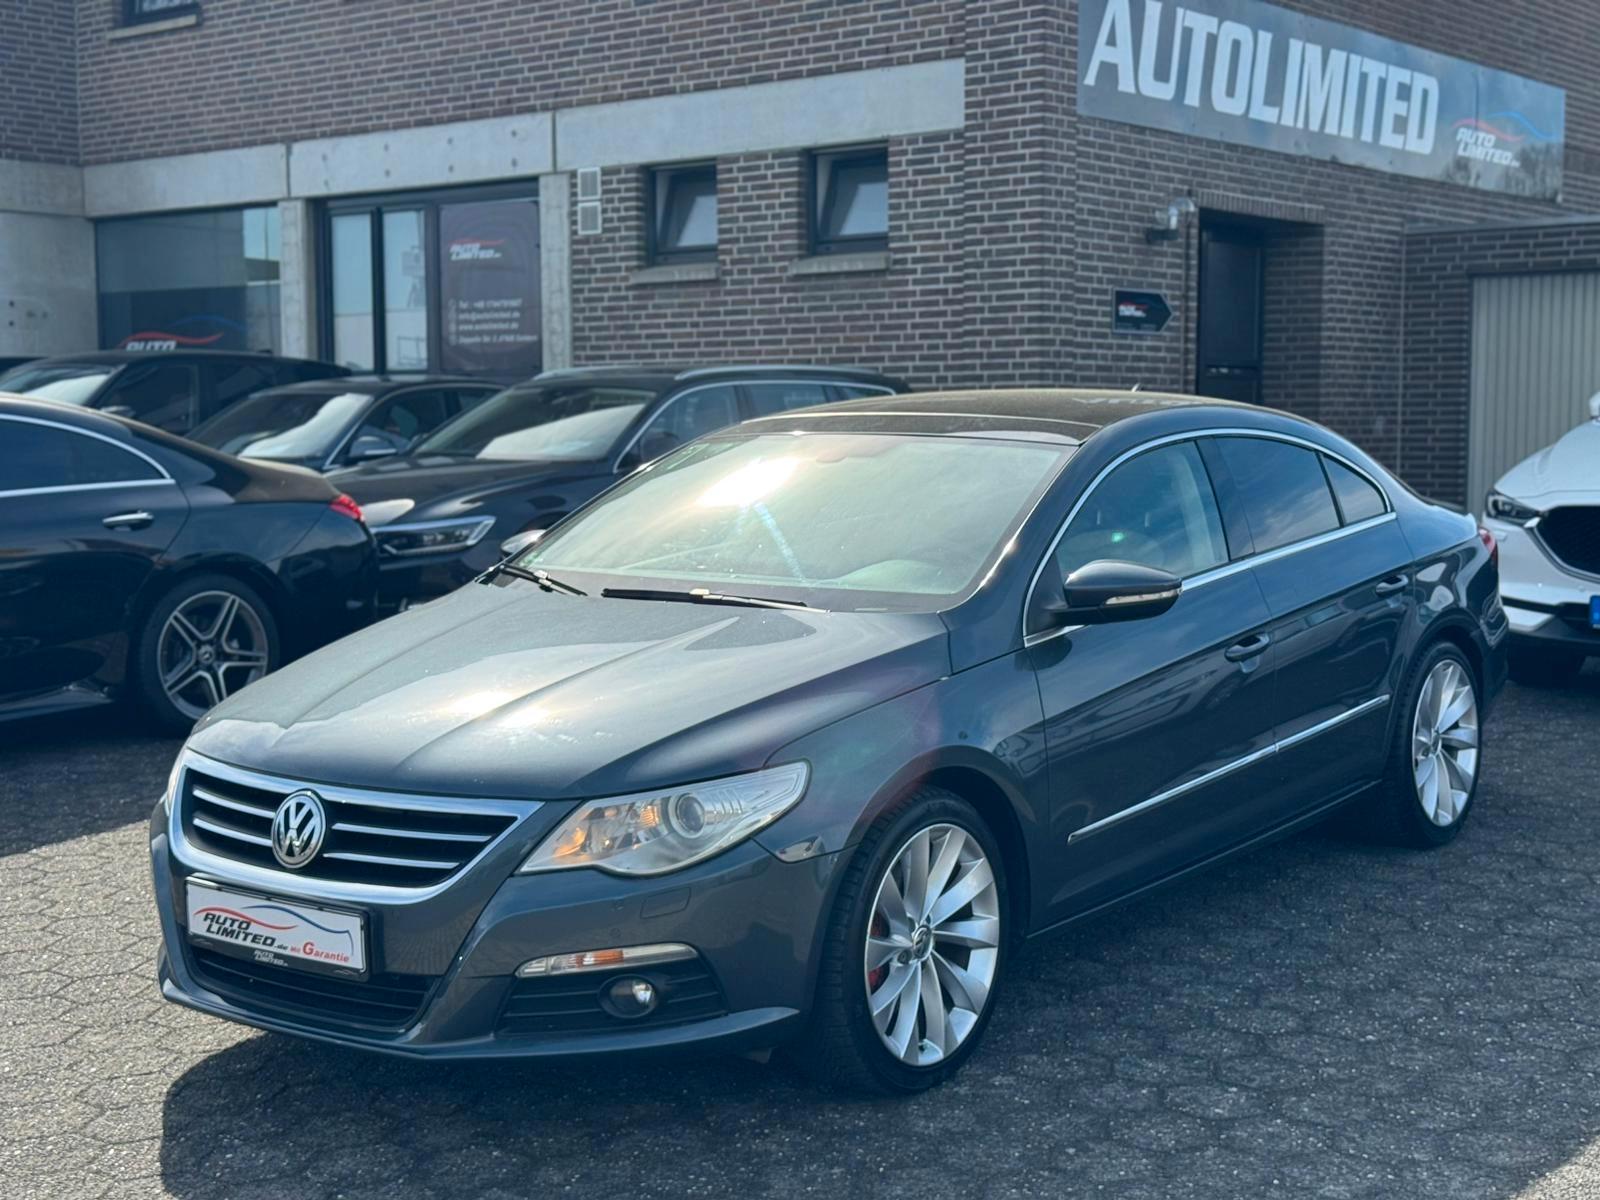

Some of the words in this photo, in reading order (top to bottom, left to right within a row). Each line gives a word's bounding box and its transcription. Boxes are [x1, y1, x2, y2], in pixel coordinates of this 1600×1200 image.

[1083, 0, 1439, 155] AUTOLIMITED
[1456, 127, 1496, 148] AUTO
[203, 912, 251, 931] AUTO
[303, 941, 350, 963] Garantie
